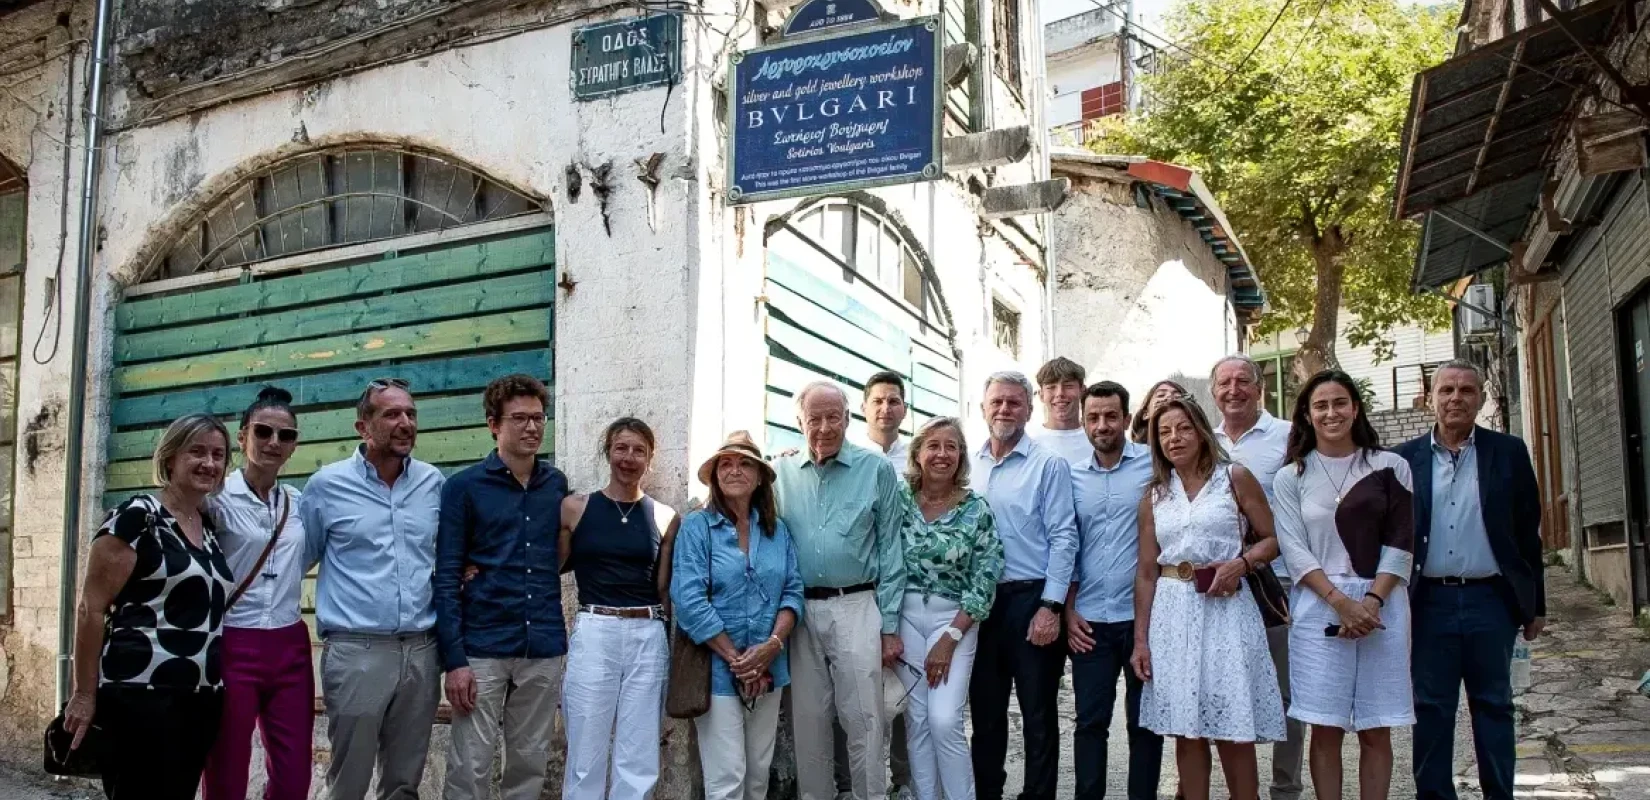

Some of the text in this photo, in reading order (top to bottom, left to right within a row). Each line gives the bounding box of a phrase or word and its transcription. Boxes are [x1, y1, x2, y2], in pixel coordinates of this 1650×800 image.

[602, 27, 647, 52] ΟΔΟΣ
[741, 63, 924, 105] silver and gold jewellery workshop
[747, 86, 917, 129] BVLGARI
[786, 138, 875, 160] Sotirios Voulgaris
[755, 180, 767, 188] This
[779, 177, 789, 185] the
[848, 168, 855, 177] of
[856, 167, 867, 175] the
